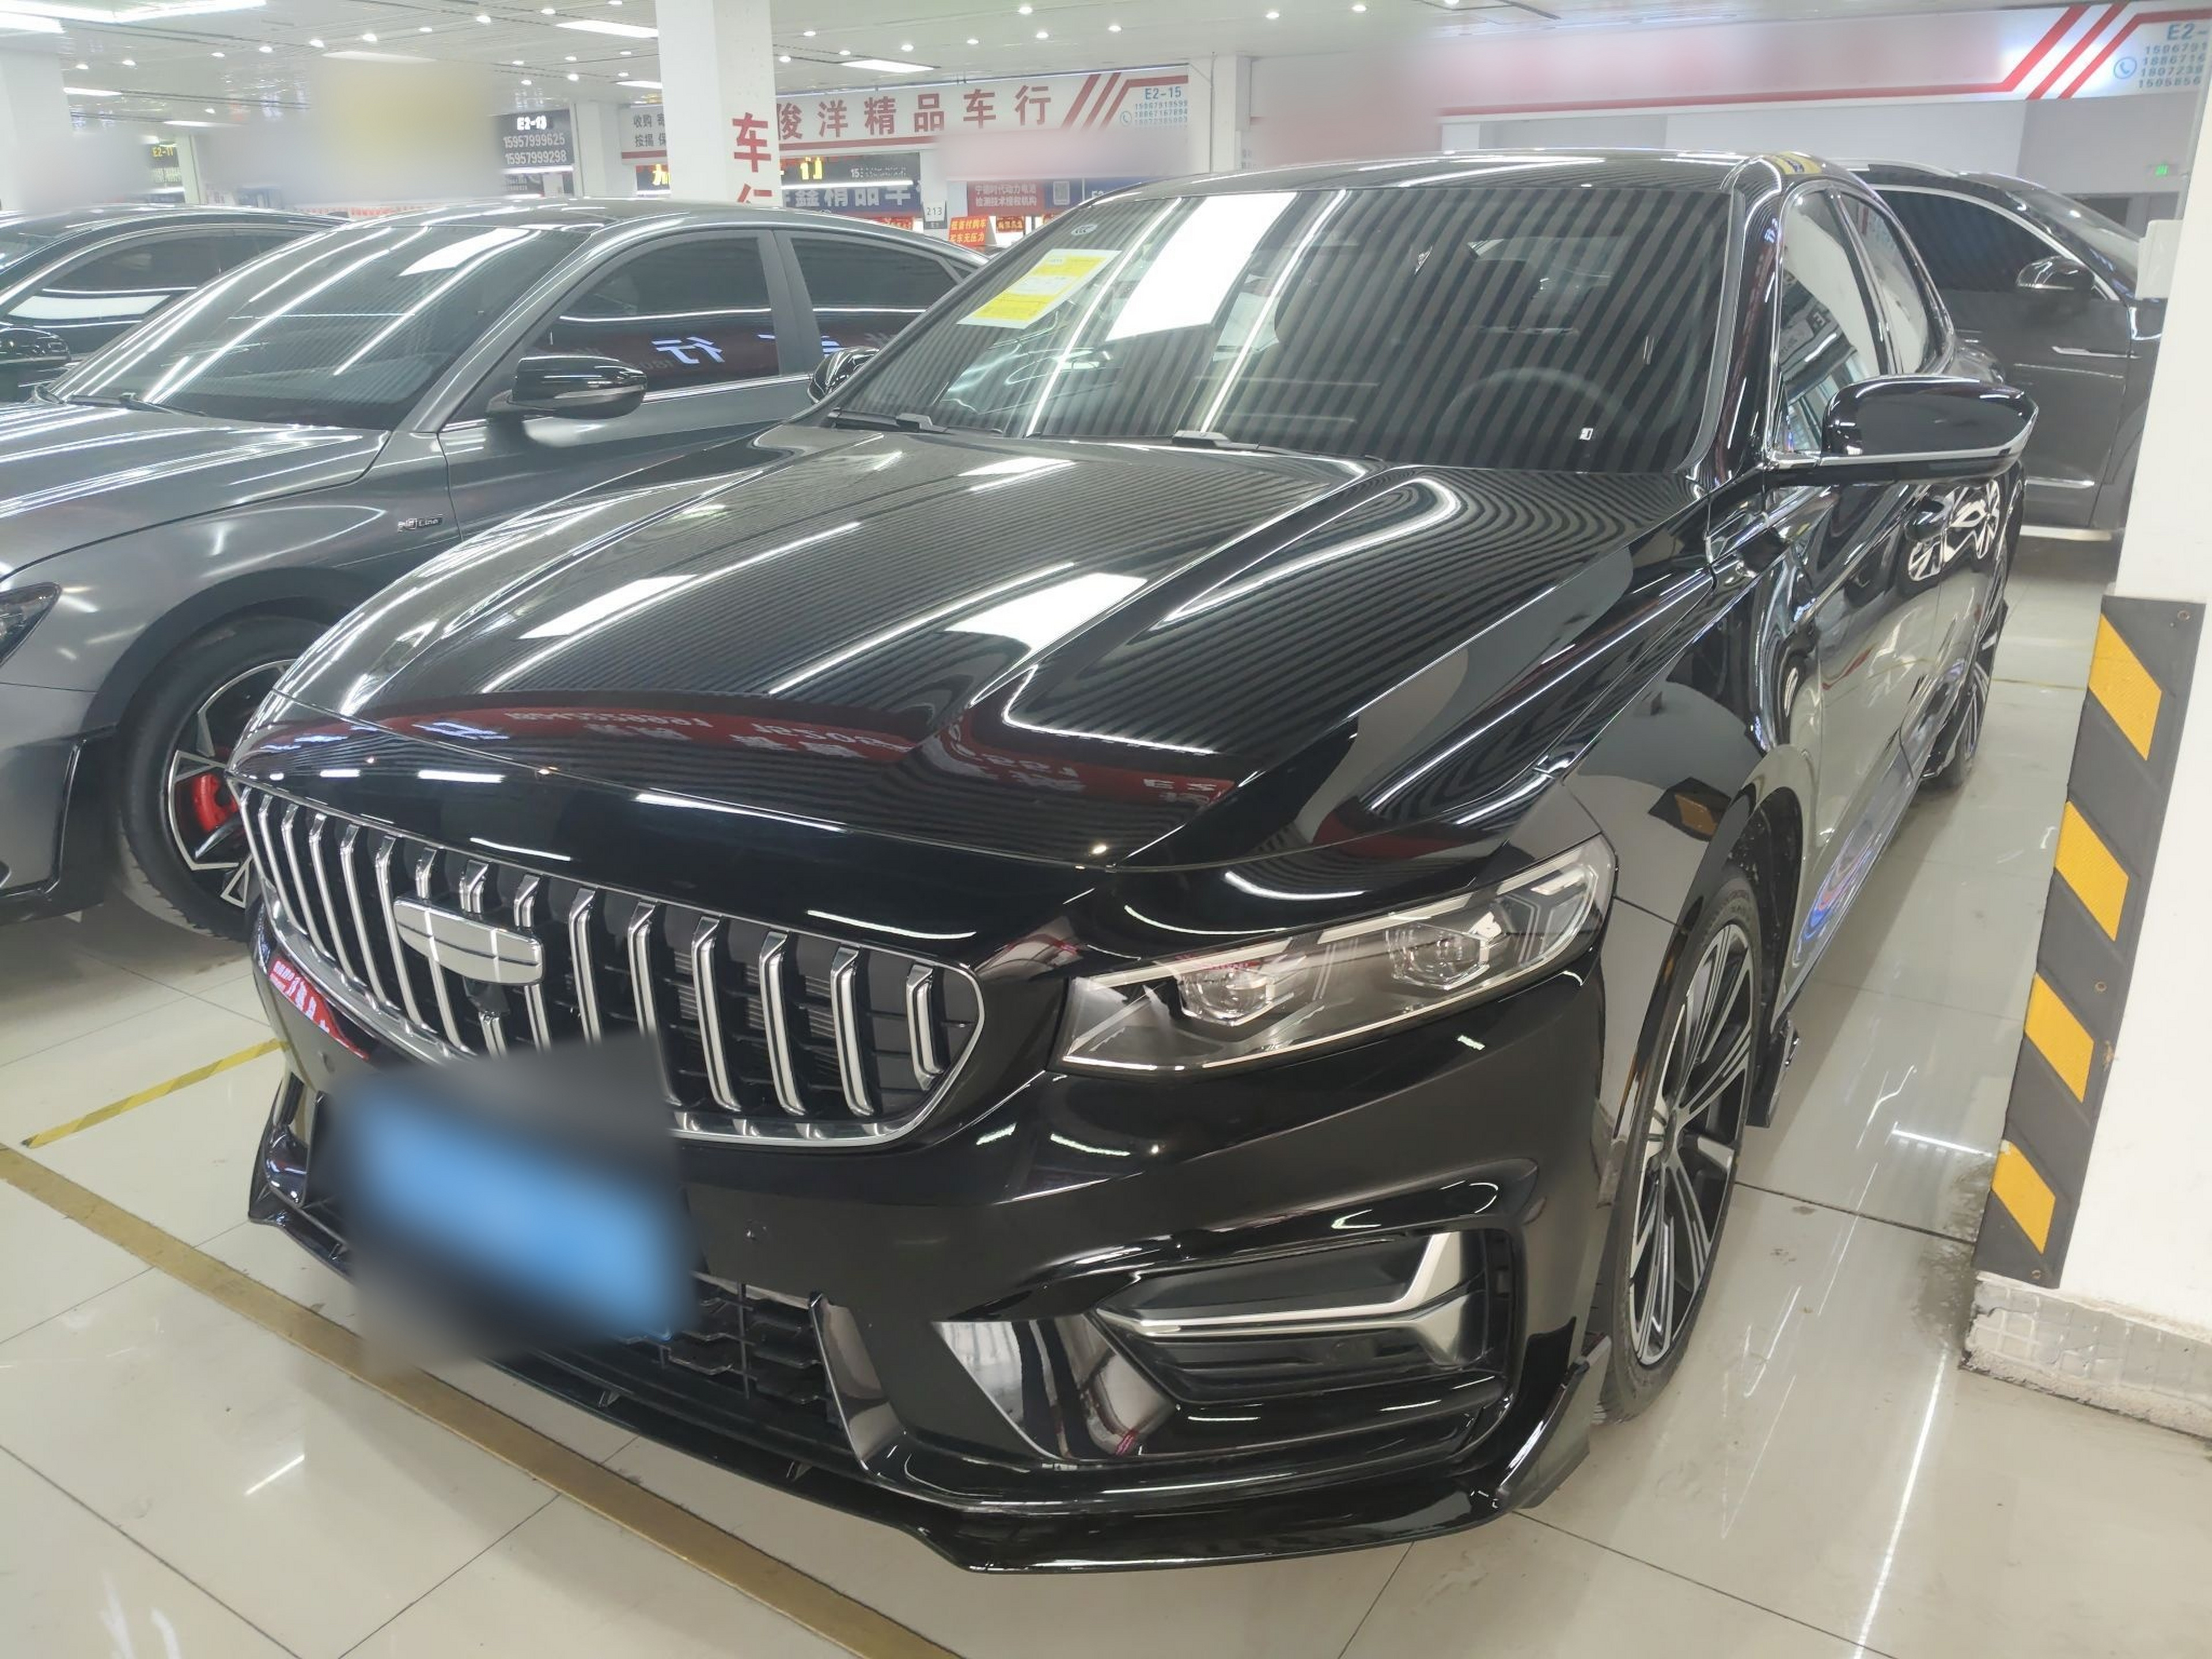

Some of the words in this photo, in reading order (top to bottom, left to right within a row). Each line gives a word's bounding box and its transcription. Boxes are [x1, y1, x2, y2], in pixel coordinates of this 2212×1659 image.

[1145, 86, 1181, 100] E2-15
[503, 132, 565, 149] 15957999625
[505, 150, 567, 165] 15957999298
[926, 207, 942, 216] 213
